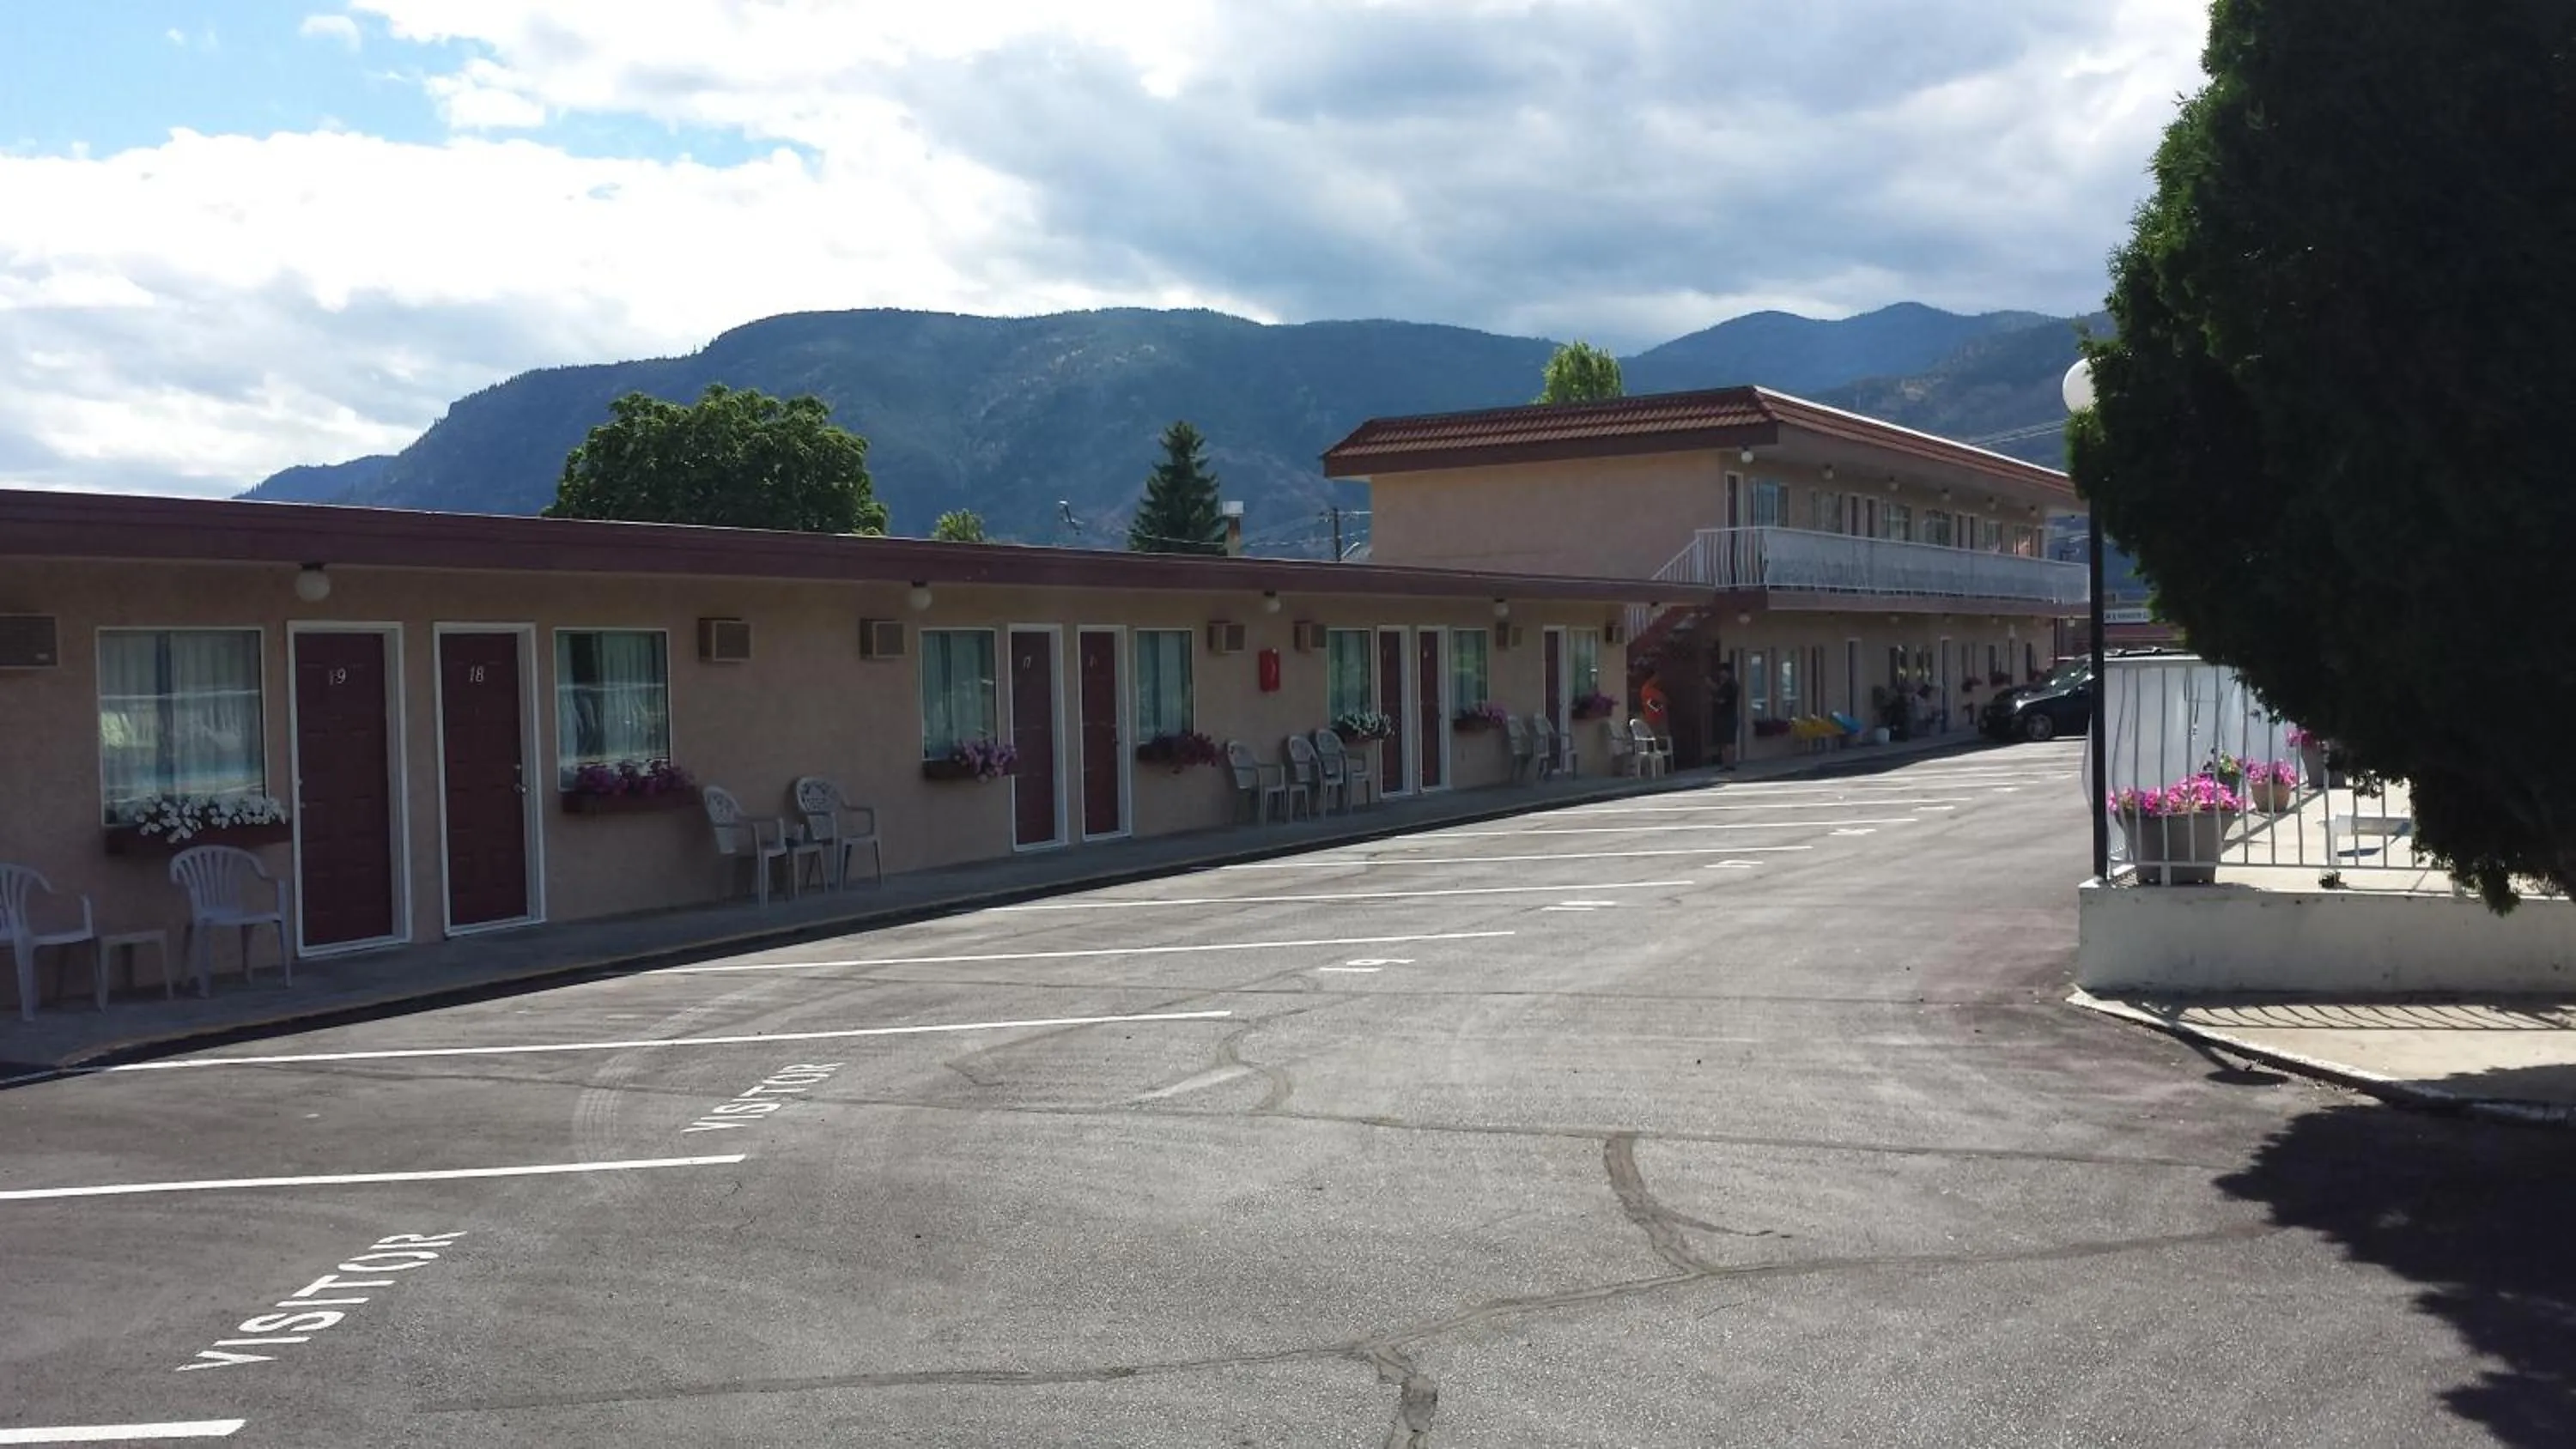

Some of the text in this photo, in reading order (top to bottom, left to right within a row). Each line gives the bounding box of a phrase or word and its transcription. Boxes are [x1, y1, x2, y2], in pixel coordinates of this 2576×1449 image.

[328, 667, 347, 686] 19
[469, 665, 485, 682] 18
[1318, 958, 1416, 973] 19
[679, 1061, 847, 1133] VISITOR
[174, 1230, 469, 1372] VISITOR
